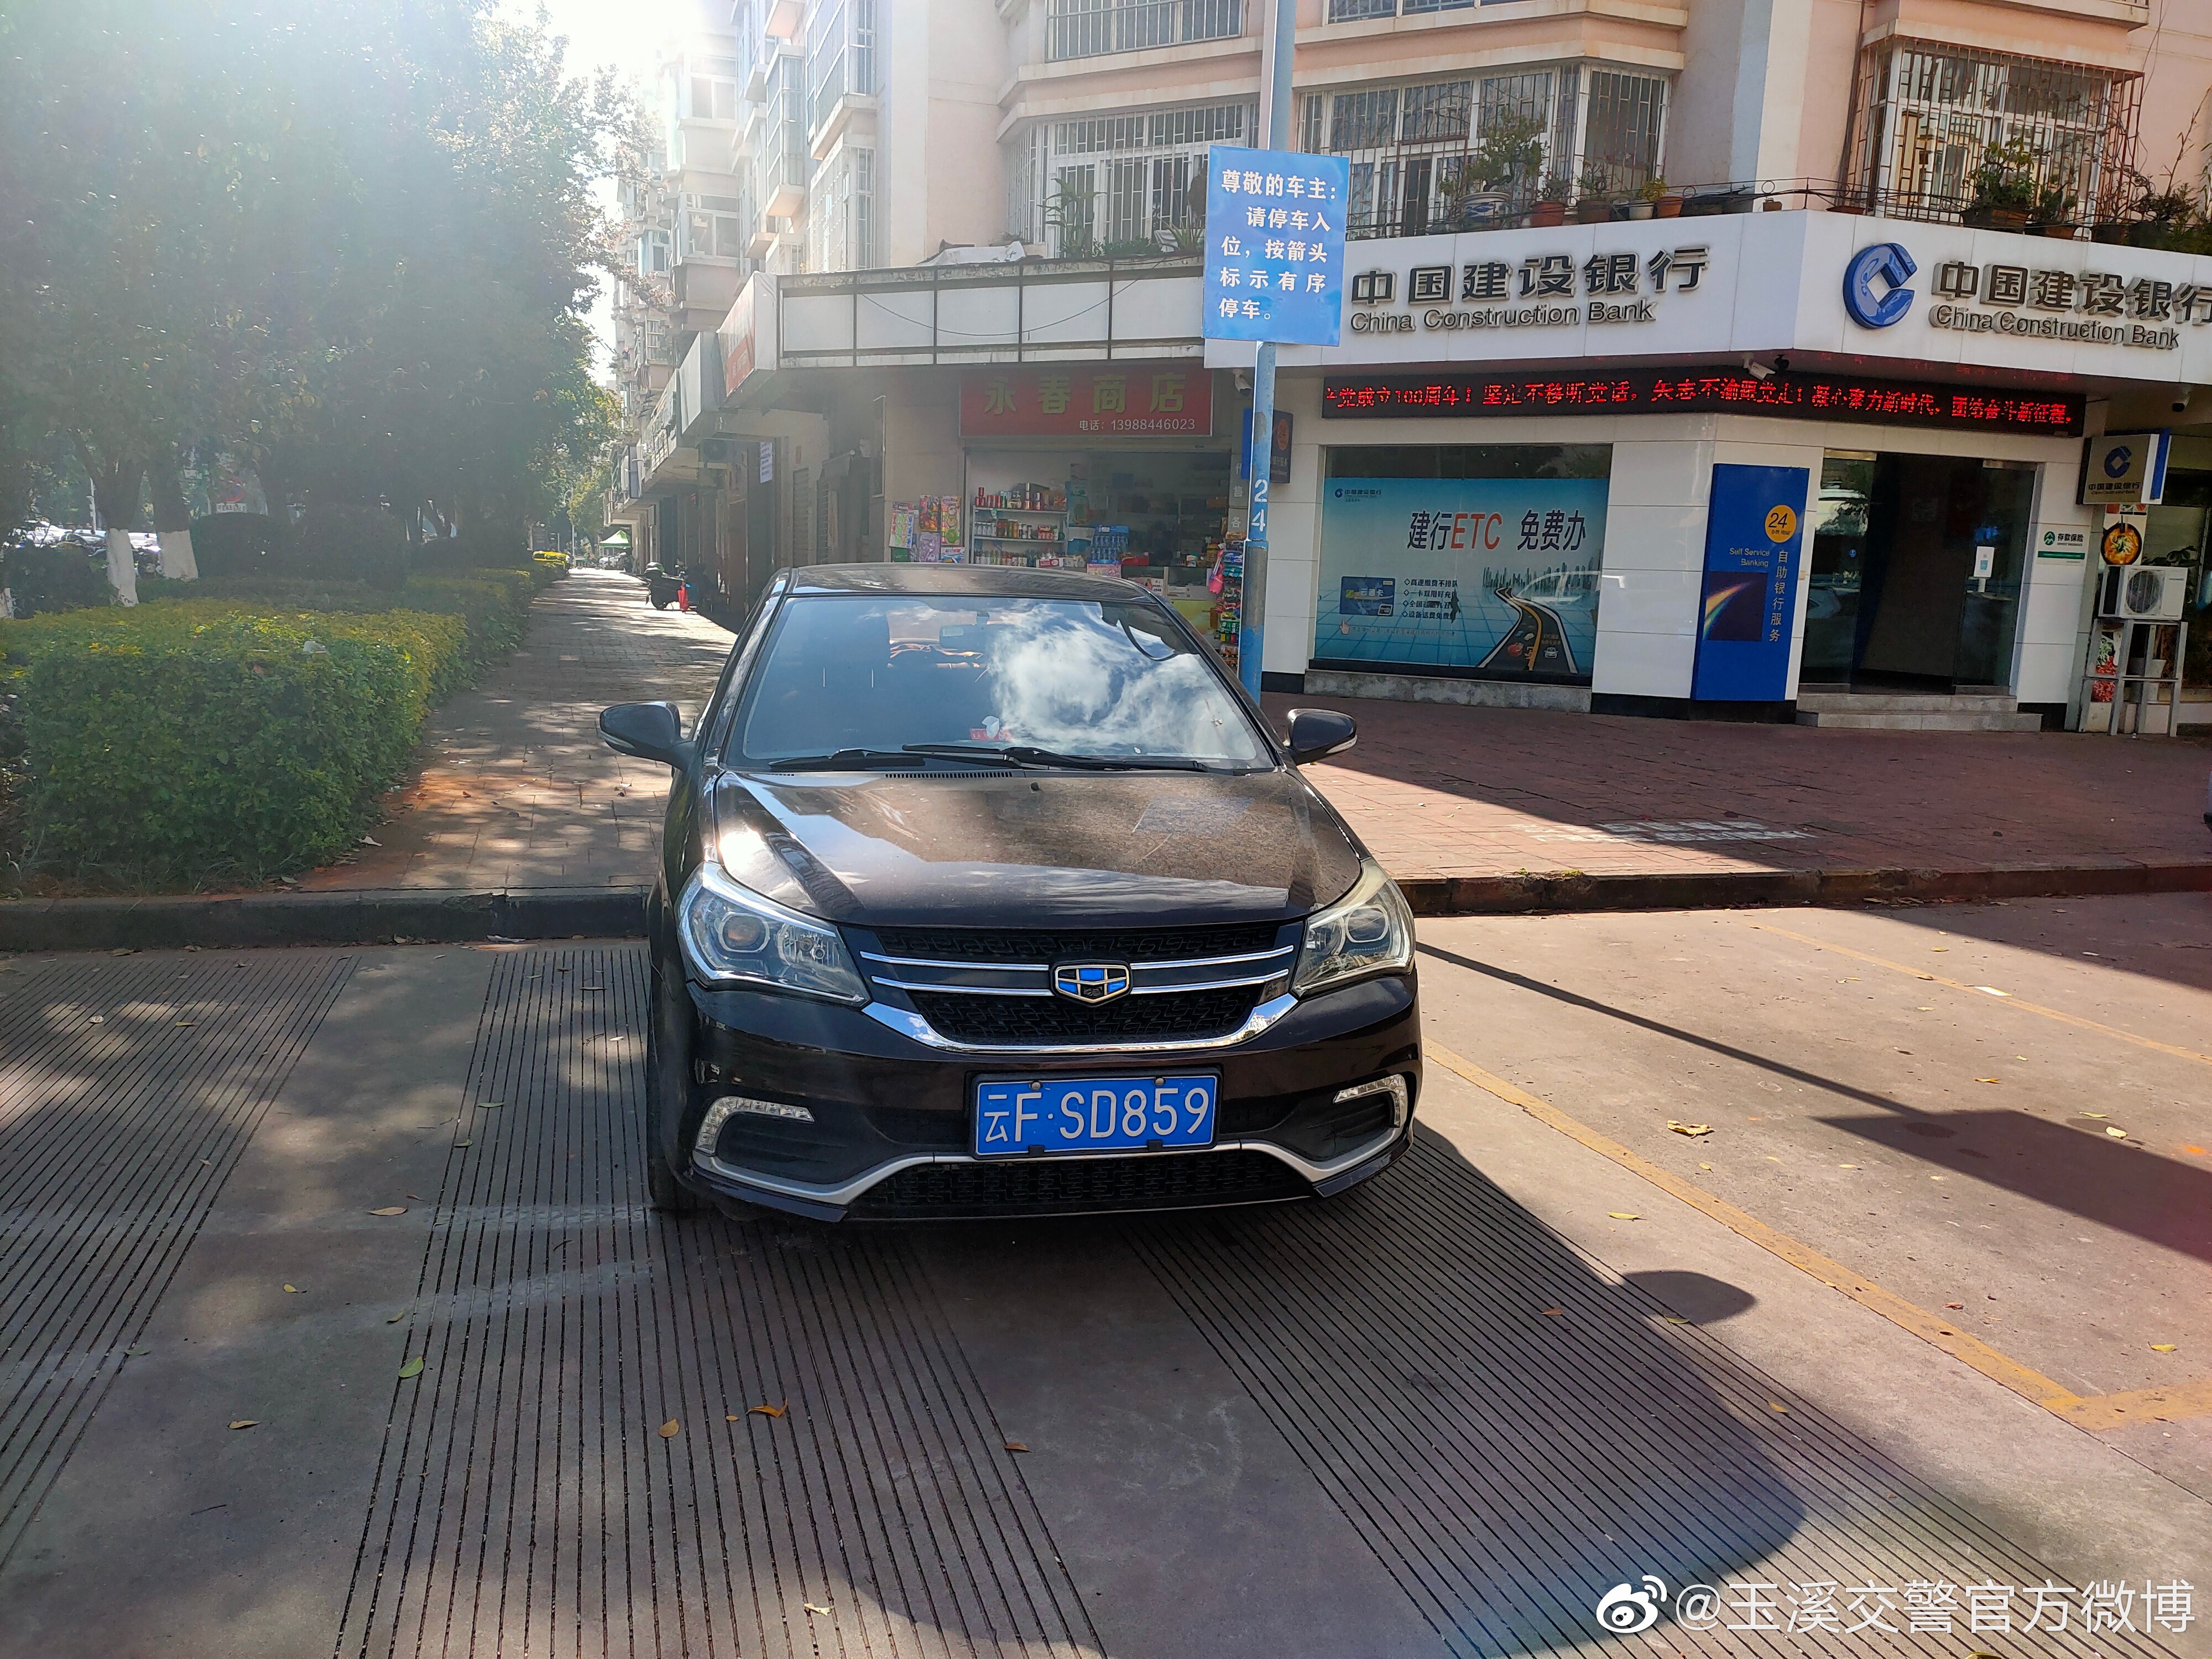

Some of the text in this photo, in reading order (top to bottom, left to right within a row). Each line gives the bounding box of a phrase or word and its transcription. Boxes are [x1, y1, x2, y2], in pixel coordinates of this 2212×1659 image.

[1221, 169, 1335, 200] 尊敬的车主：
[1246, 206, 1331, 232] 请停车入
[1219, 267, 1327, 294] 标示有序
[1351, 247, 1709, 305] 中国建设银行
[1932, 261, 2212, 325] 中国建设银行
[1218, 298, 1271, 320] 停车。
[1351, 298, 1657, 333] China Construction Bank
[1930, 304, 2180, 351] China Construction Bank
[984, 372, 1187, 415] 永春商店
[1517, 509, 1587, 551] 免费办
[1768, 512, 1788, 529] 24
[1729, 547, 1770, 556] Self Service
[2058, 533, 2084, 542] 存款保险
[1741, 558, 1768, 568] Banking
[1410, 590, 1457, 598] 一卡双用好充
[1768, 549, 1788, 643] 自助银行服务
